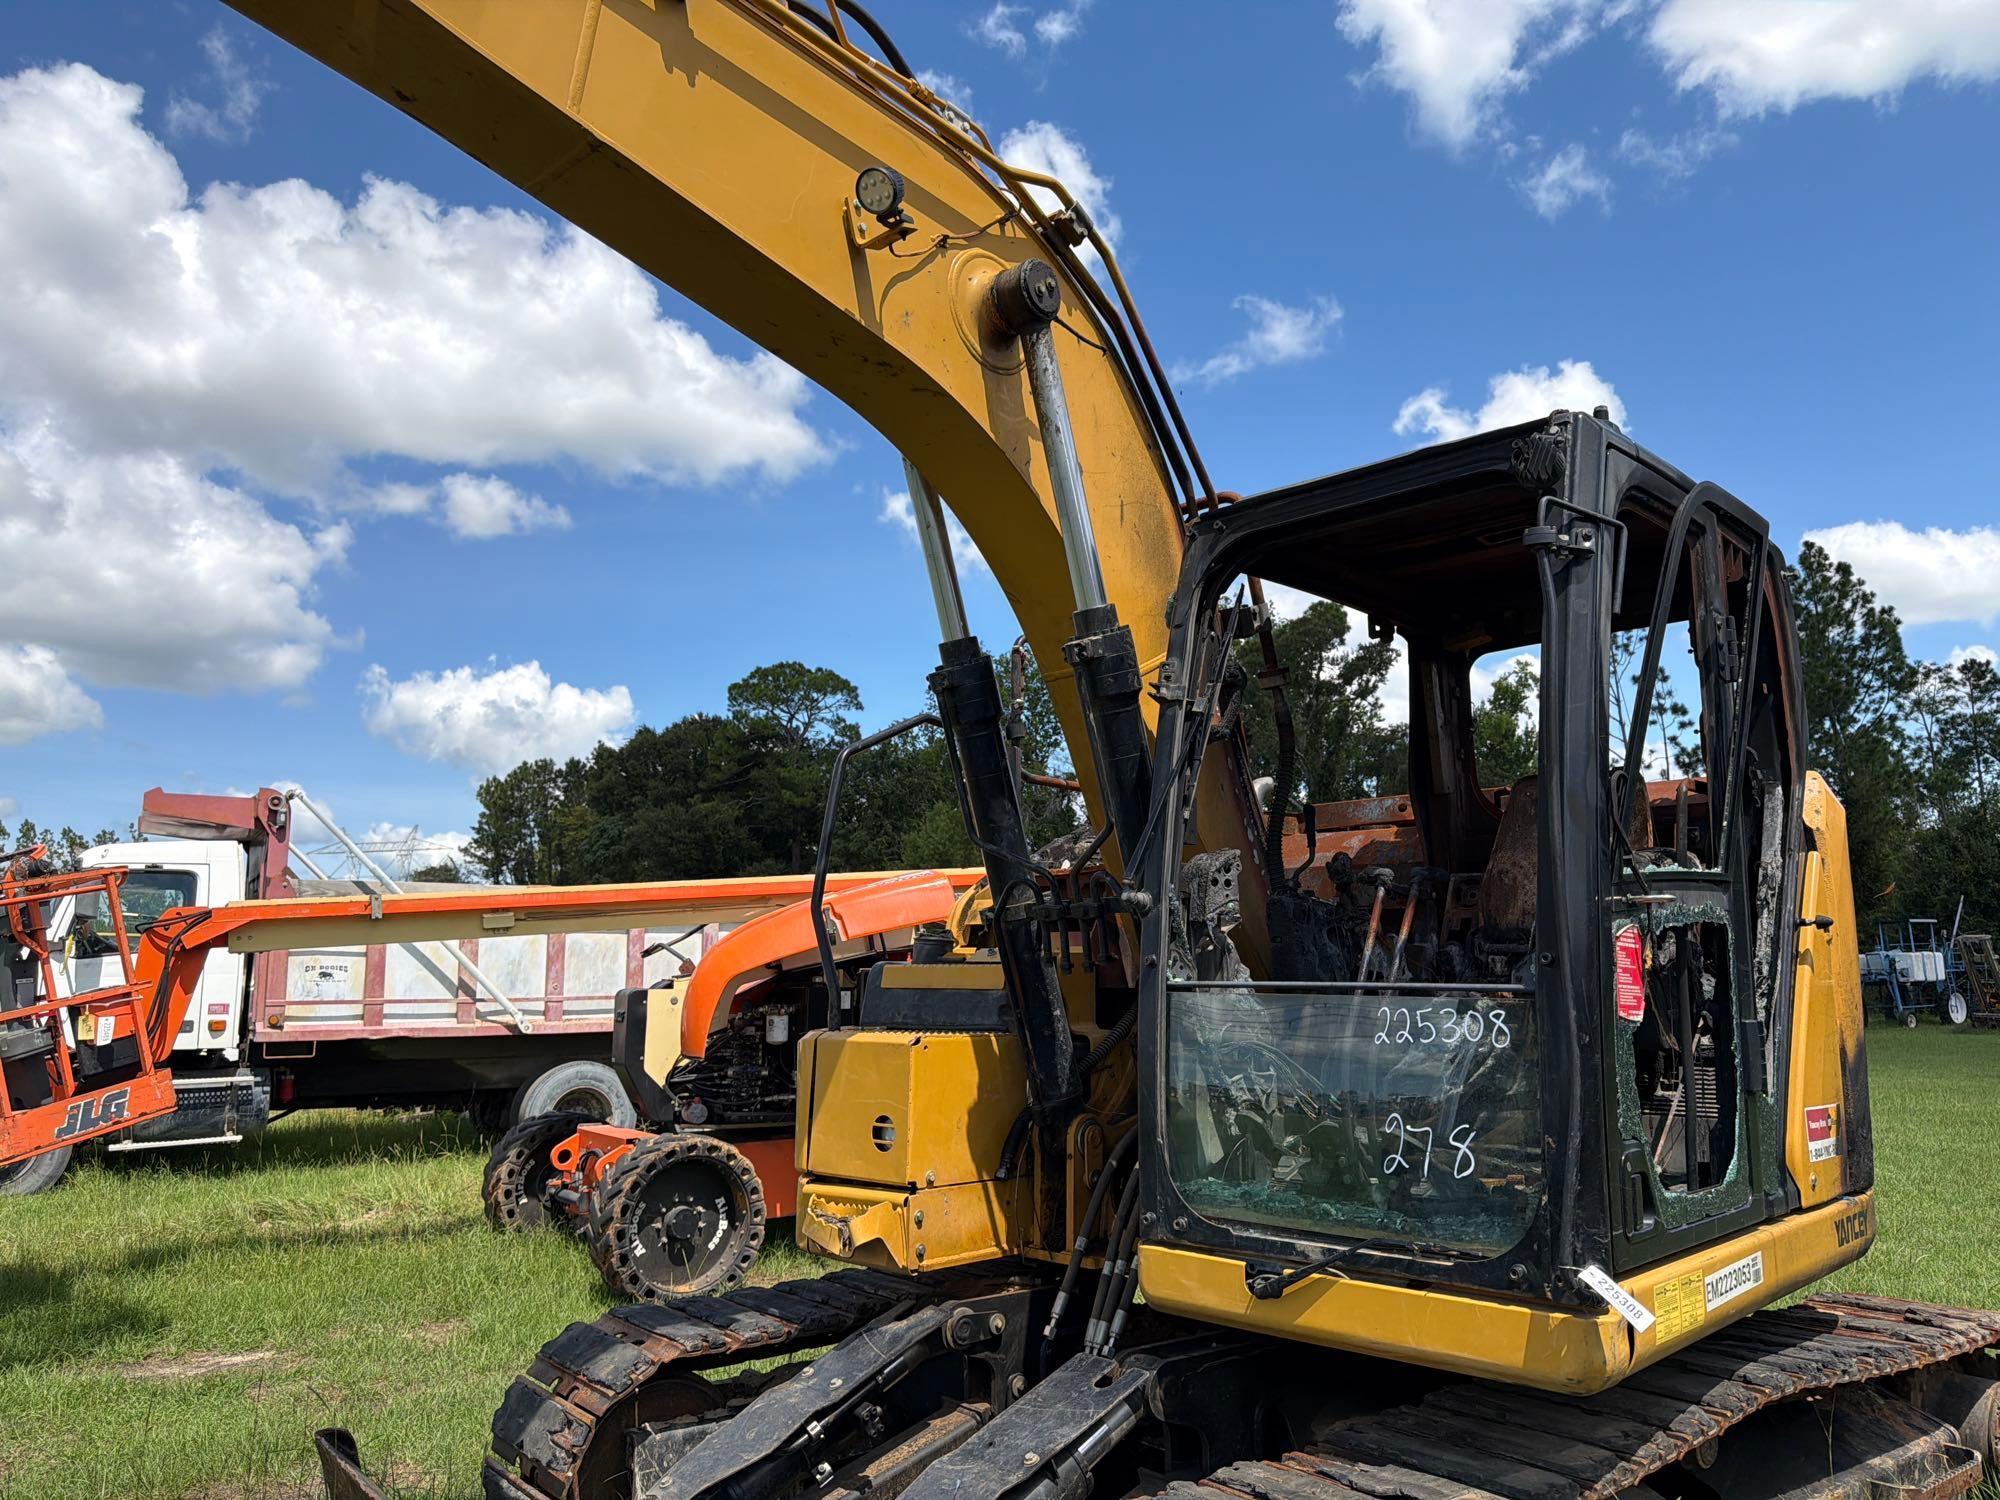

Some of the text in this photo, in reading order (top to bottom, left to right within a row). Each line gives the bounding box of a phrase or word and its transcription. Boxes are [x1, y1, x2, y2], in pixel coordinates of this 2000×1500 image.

[319, 964, 349, 973] BODIES
[1375, 1006, 1511, 1048] 225308
[54, 1086, 131, 1140] JLG
[1384, 1112, 1476, 1179] 278
[1834, 1209, 1868, 1247] YANCEY
[1597, 1276, 1645, 1320] 225308
[1706, 1262, 1752, 1303] EM2223053
